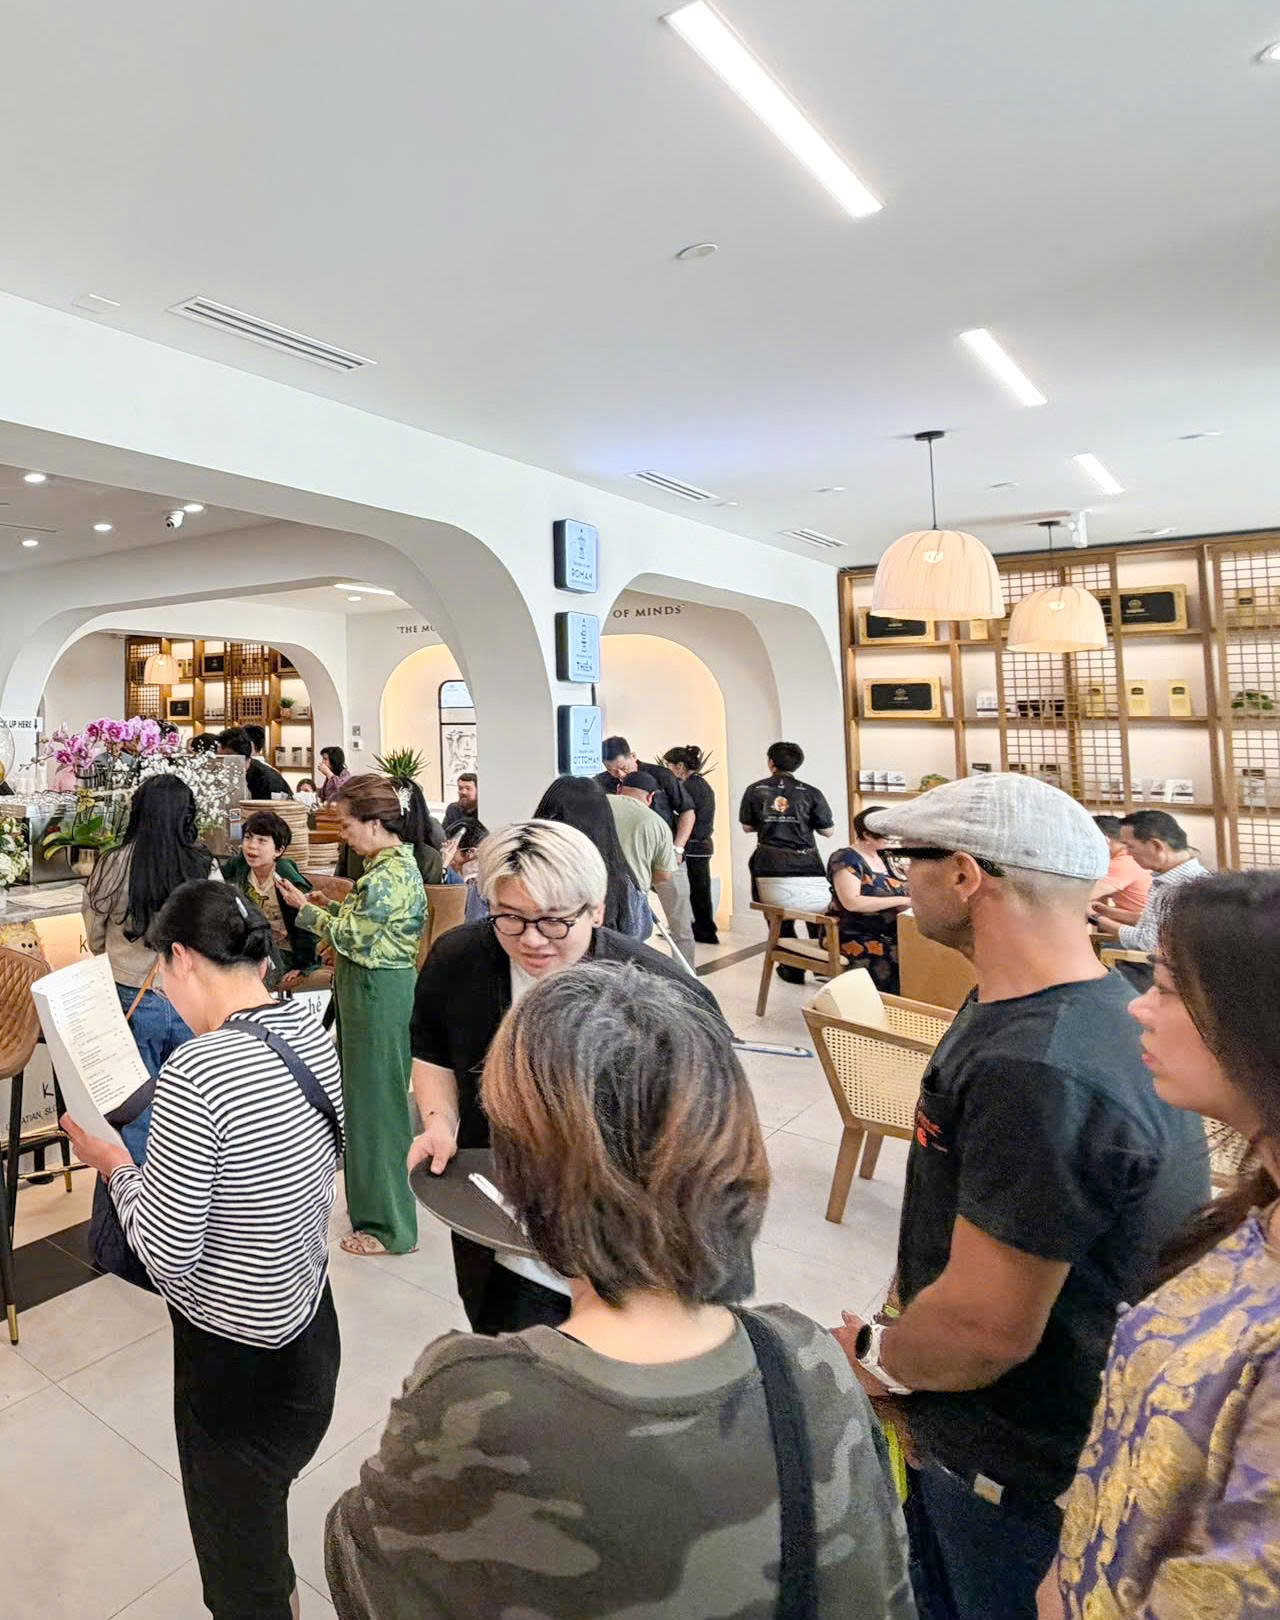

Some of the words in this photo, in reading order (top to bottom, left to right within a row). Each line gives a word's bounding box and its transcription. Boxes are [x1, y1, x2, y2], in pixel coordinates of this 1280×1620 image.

[613, 609, 630, 618] OF
[9, 720, 17, 729] UP
[18, 720, 32, 729] HERE
